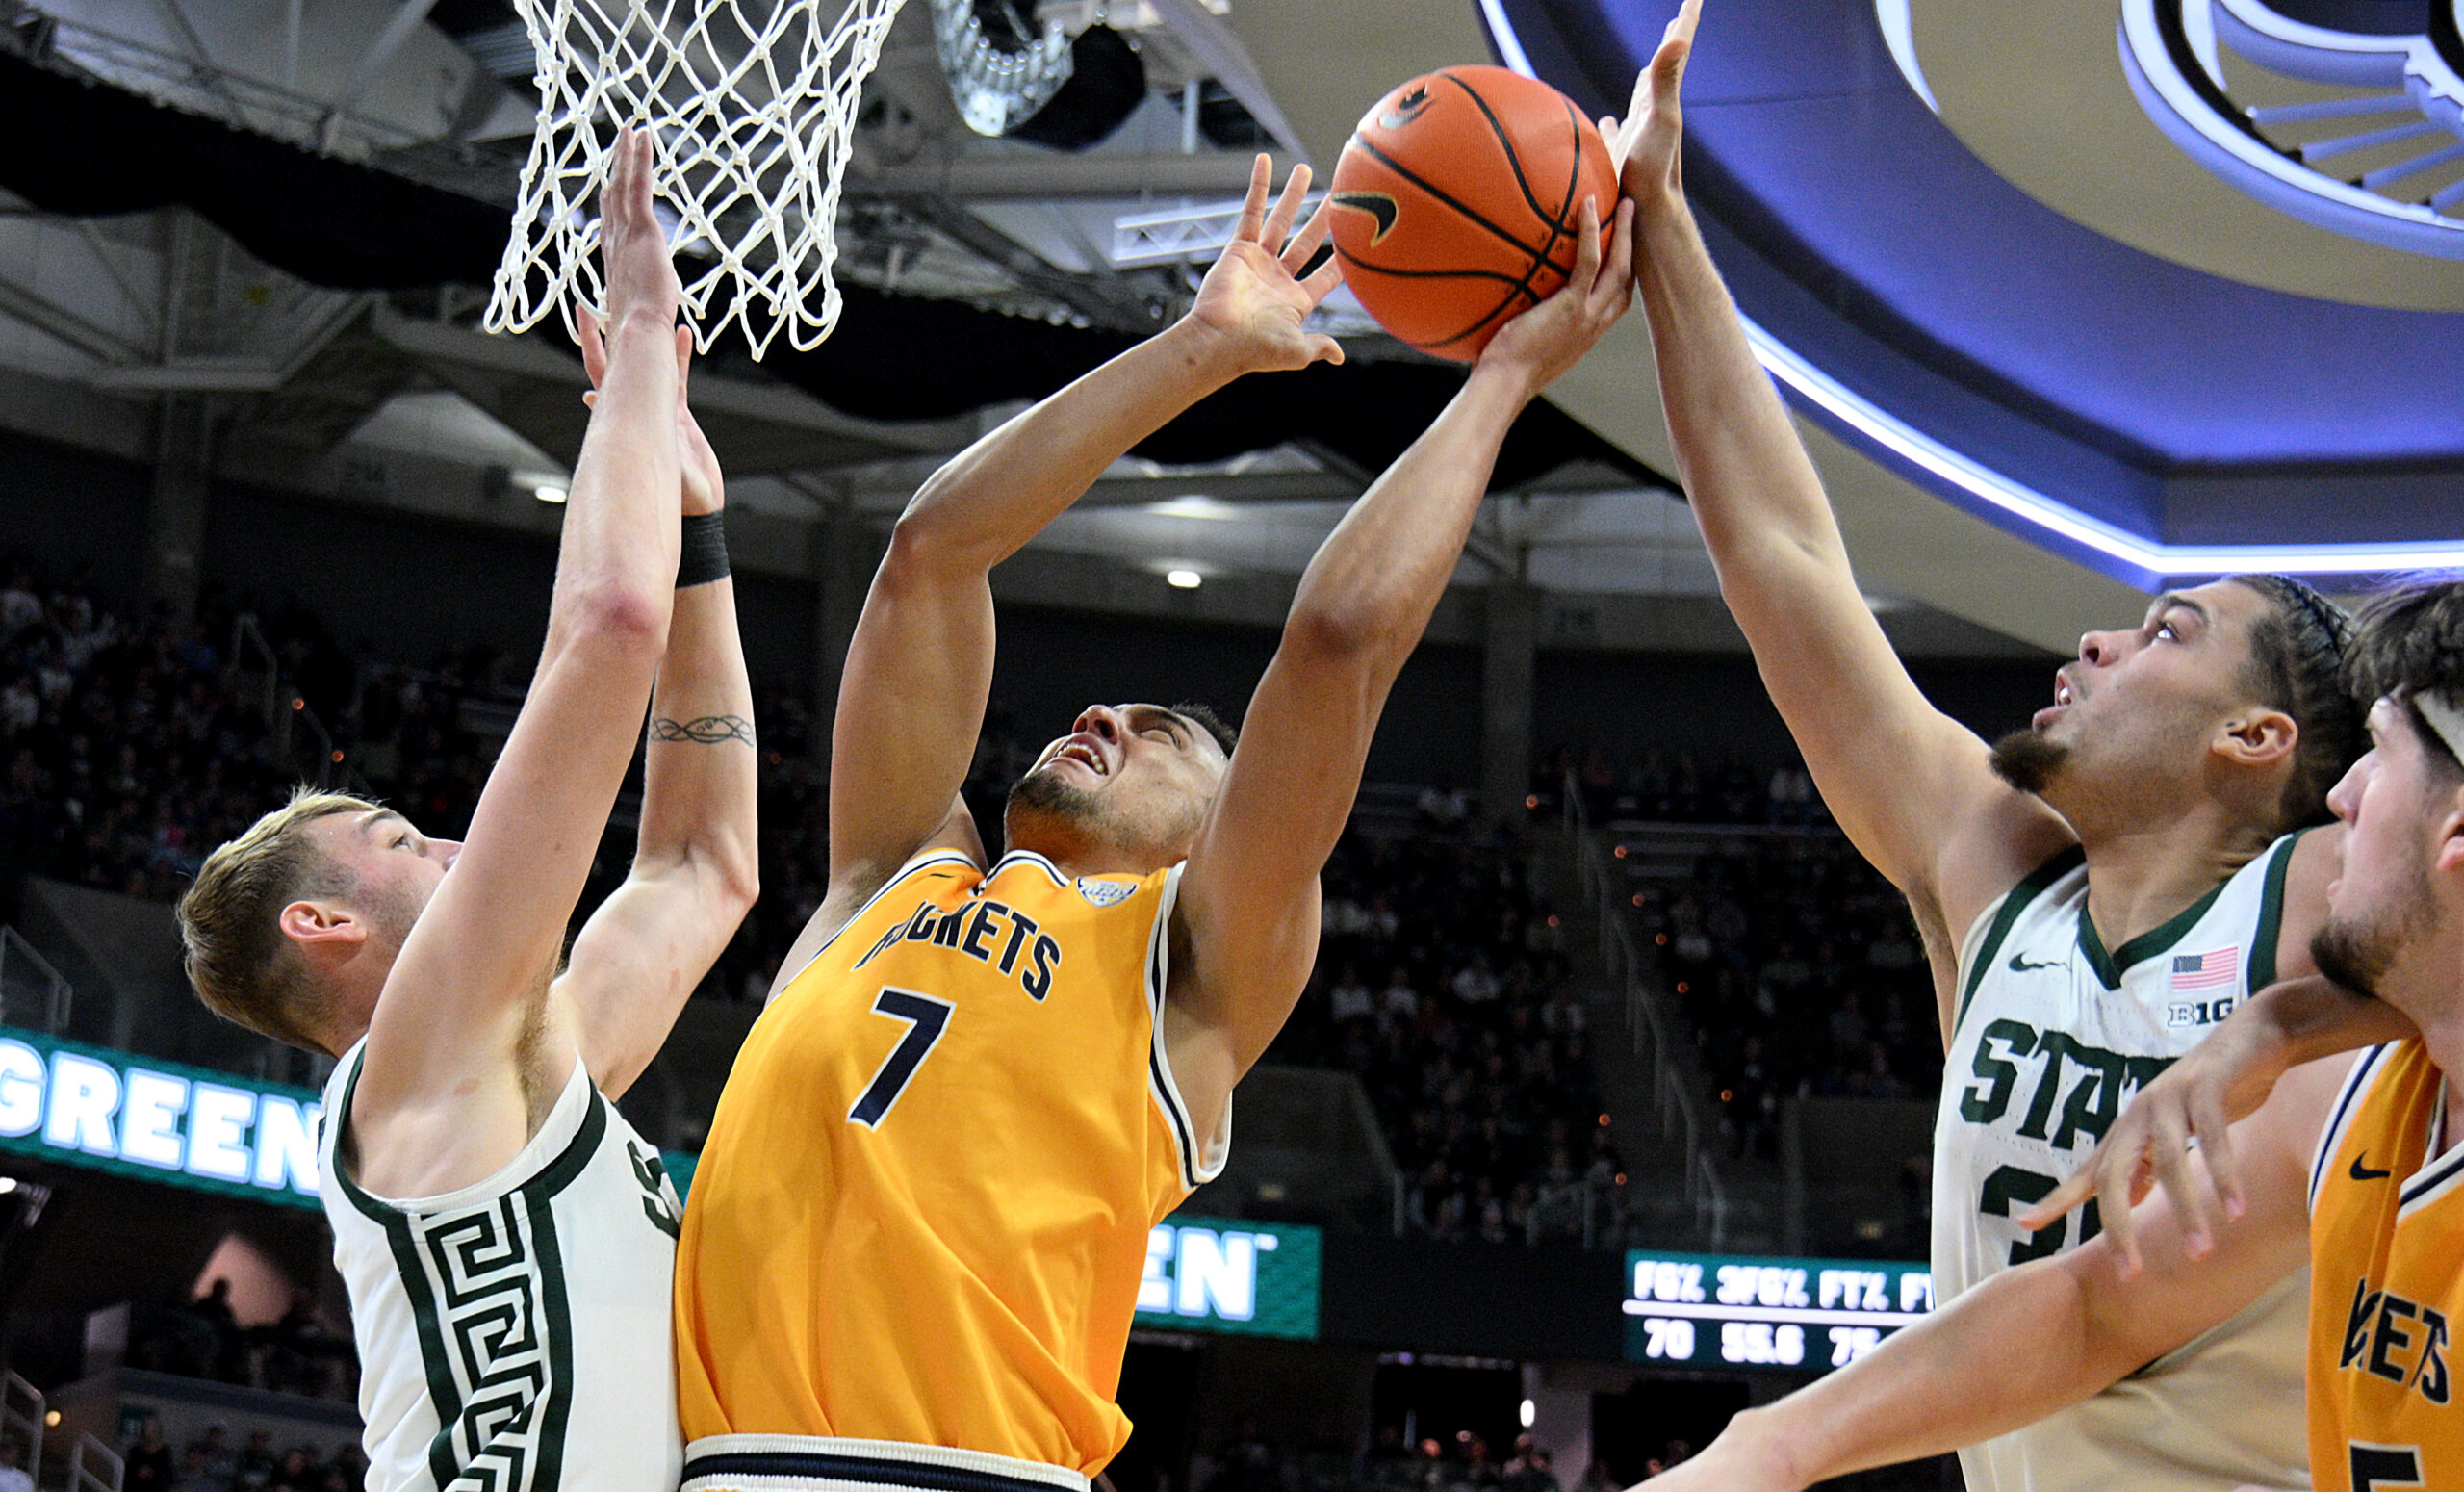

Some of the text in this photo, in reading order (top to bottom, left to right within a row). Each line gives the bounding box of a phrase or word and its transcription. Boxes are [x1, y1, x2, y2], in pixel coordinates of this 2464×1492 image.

[0, 1037, 323, 1196] GREEN
[846, 985, 957, 1133] 7
[1643, 1318, 1695, 1360] 70
